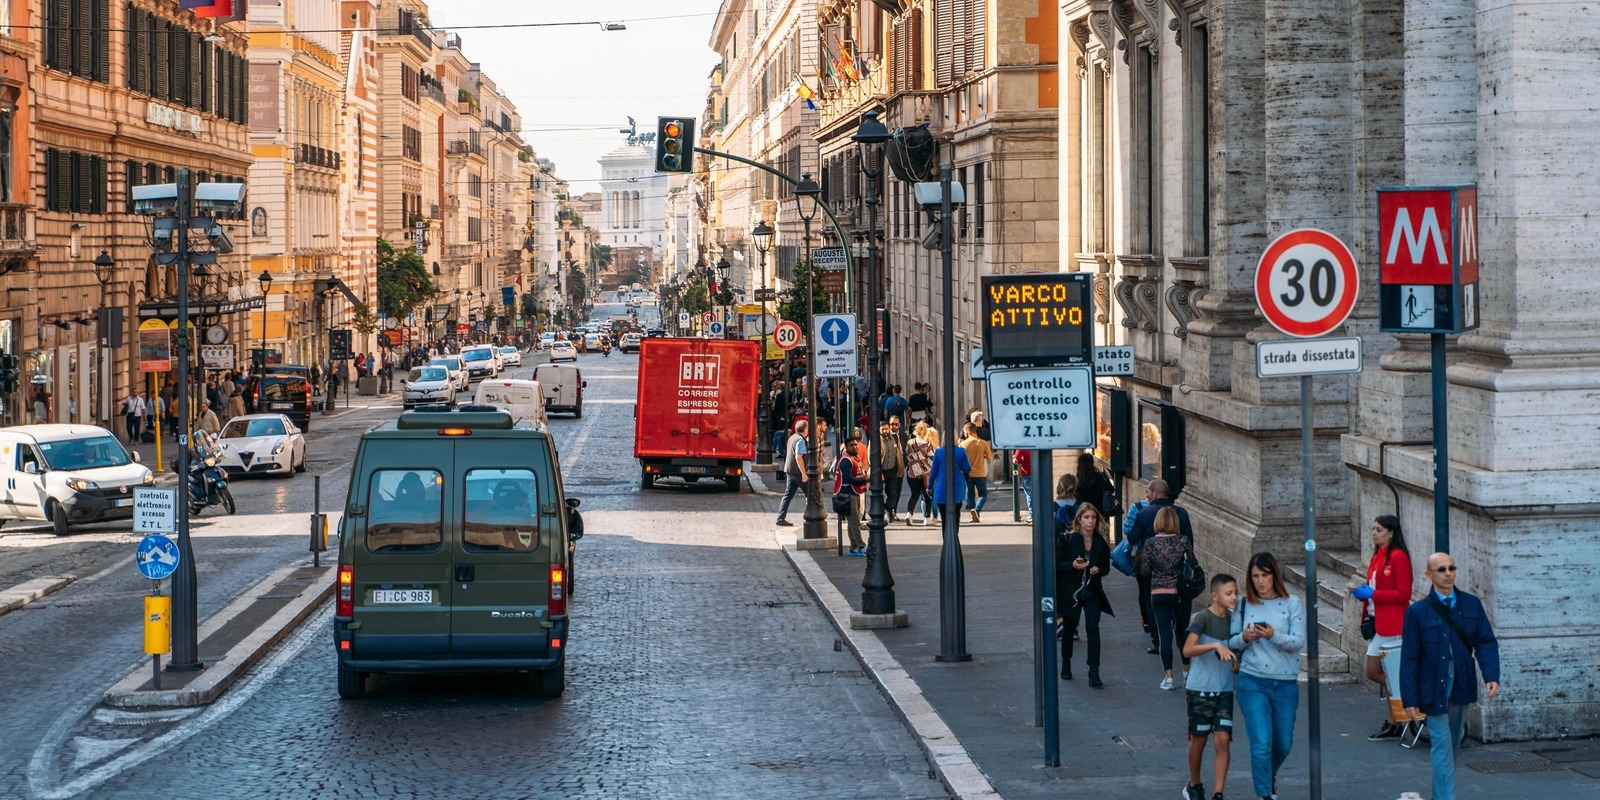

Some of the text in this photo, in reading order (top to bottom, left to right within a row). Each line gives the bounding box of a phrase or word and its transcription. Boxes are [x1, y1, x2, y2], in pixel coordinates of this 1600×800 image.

[249, 85, 270, 93] GARDEN
[248, 101, 273, 109] STAURANT
[254, 111, 264, 120] BAR
[1385, 207, 1449, 264] M
[1460, 204, 1477, 266] M
[1279, 258, 1337, 308] 30
[990, 284, 1066, 304] VARCO
[991, 306, 1082, 327] ATTIVO
[779, 329, 796, 342] 30
[1263, 347, 1356, 364] strada dissestata
[683, 361, 717, 381] BRT
[1096, 363, 1114, 372] ale
[1118, 362, 1130, 372] 15
[1007, 377, 1072, 390] controllo
[678, 389, 719, 398] CORRIERE
[1002, 393, 1080, 406] elettronico
[677, 400, 719, 408] ESPRESSO
[1015, 411, 1068, 421] accesso
[1024, 425, 1061, 438] Z.T.L.
[394, 591, 407, 602] CG
[410, 591, 430, 602] 983
